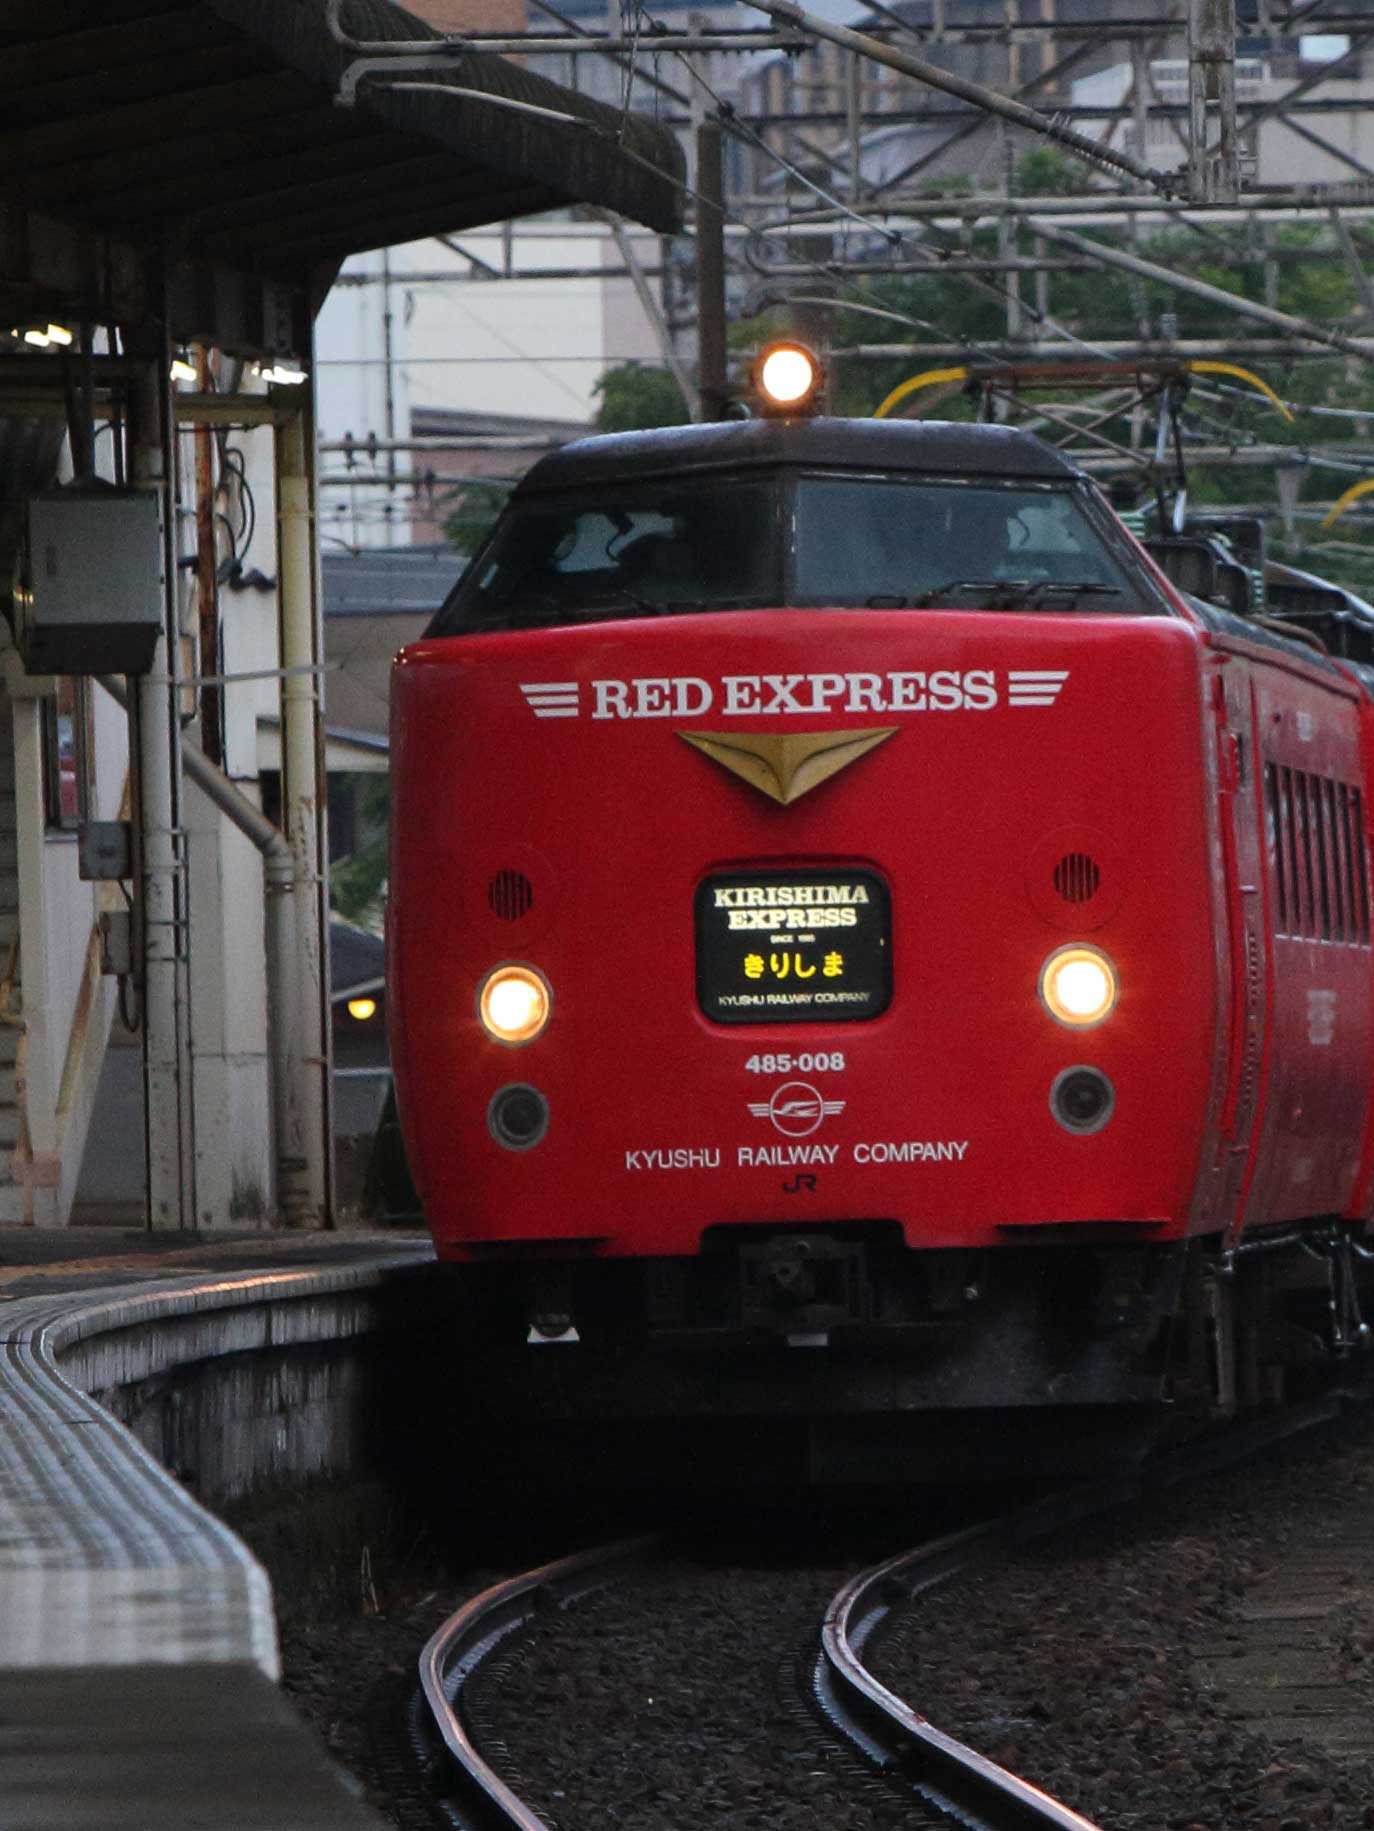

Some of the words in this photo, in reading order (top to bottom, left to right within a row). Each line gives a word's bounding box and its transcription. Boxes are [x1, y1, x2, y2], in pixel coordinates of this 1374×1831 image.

[591, 677, 713, 719] RED
[721, 670, 998, 716] EXPRESS
[714, 885, 869, 908] KIRISHIMA
[728, 908, 857, 930] EXPRESS
[744, 951, 844, 979] きりしま
[625, 1148, 720, 1170] KYUSHU
[737, 1144, 840, 1167] RAILWAY
[853, 1141, 969, 1163] COMPANY
[782, 1173, 817, 1194] JR
